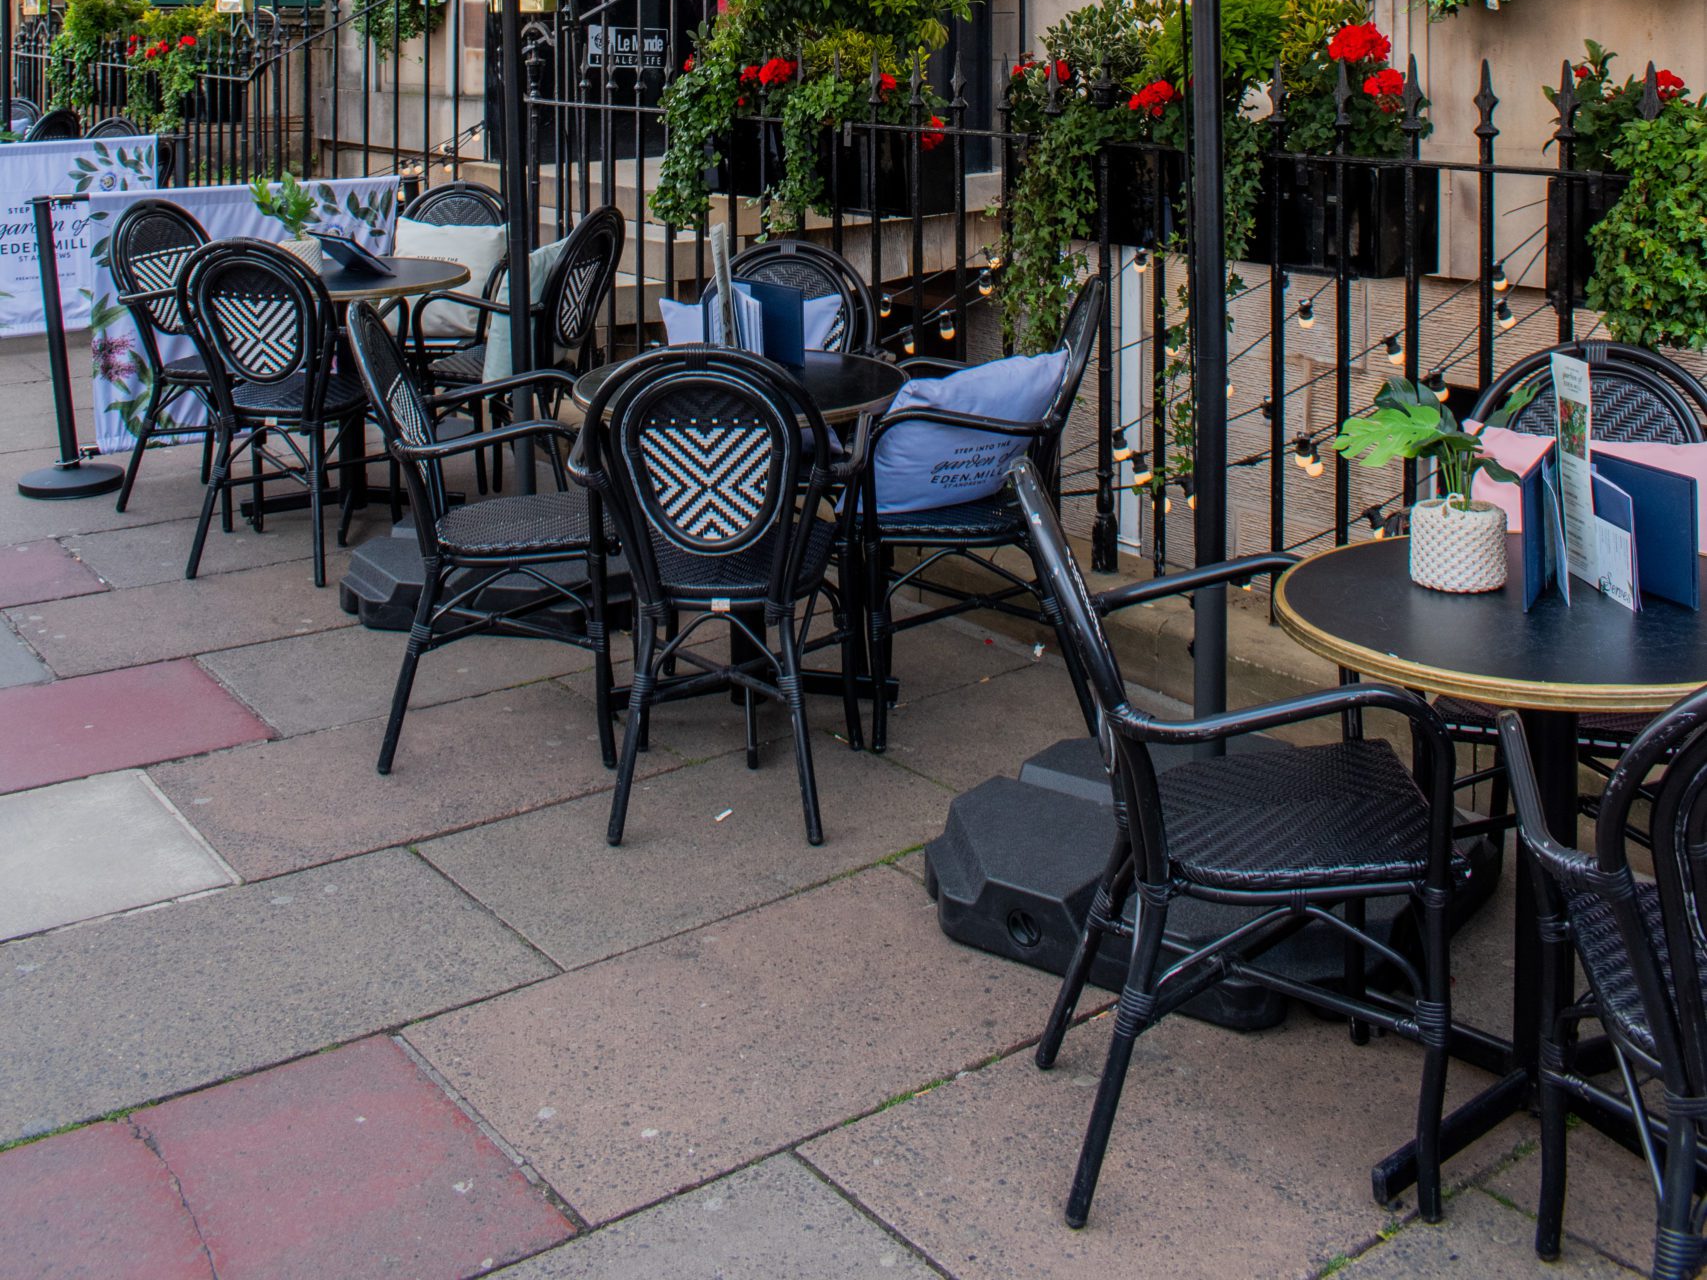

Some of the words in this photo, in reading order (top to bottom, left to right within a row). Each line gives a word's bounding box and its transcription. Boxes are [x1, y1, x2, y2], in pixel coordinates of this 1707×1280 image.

[617, 33, 631, 52] Le
[8, 206, 31, 215] STEP
[954, 447, 974, 455] STEP
[975, 443, 995, 453] INTO
[997, 439, 1012, 449] THE
[930, 453, 996, 475] garden
